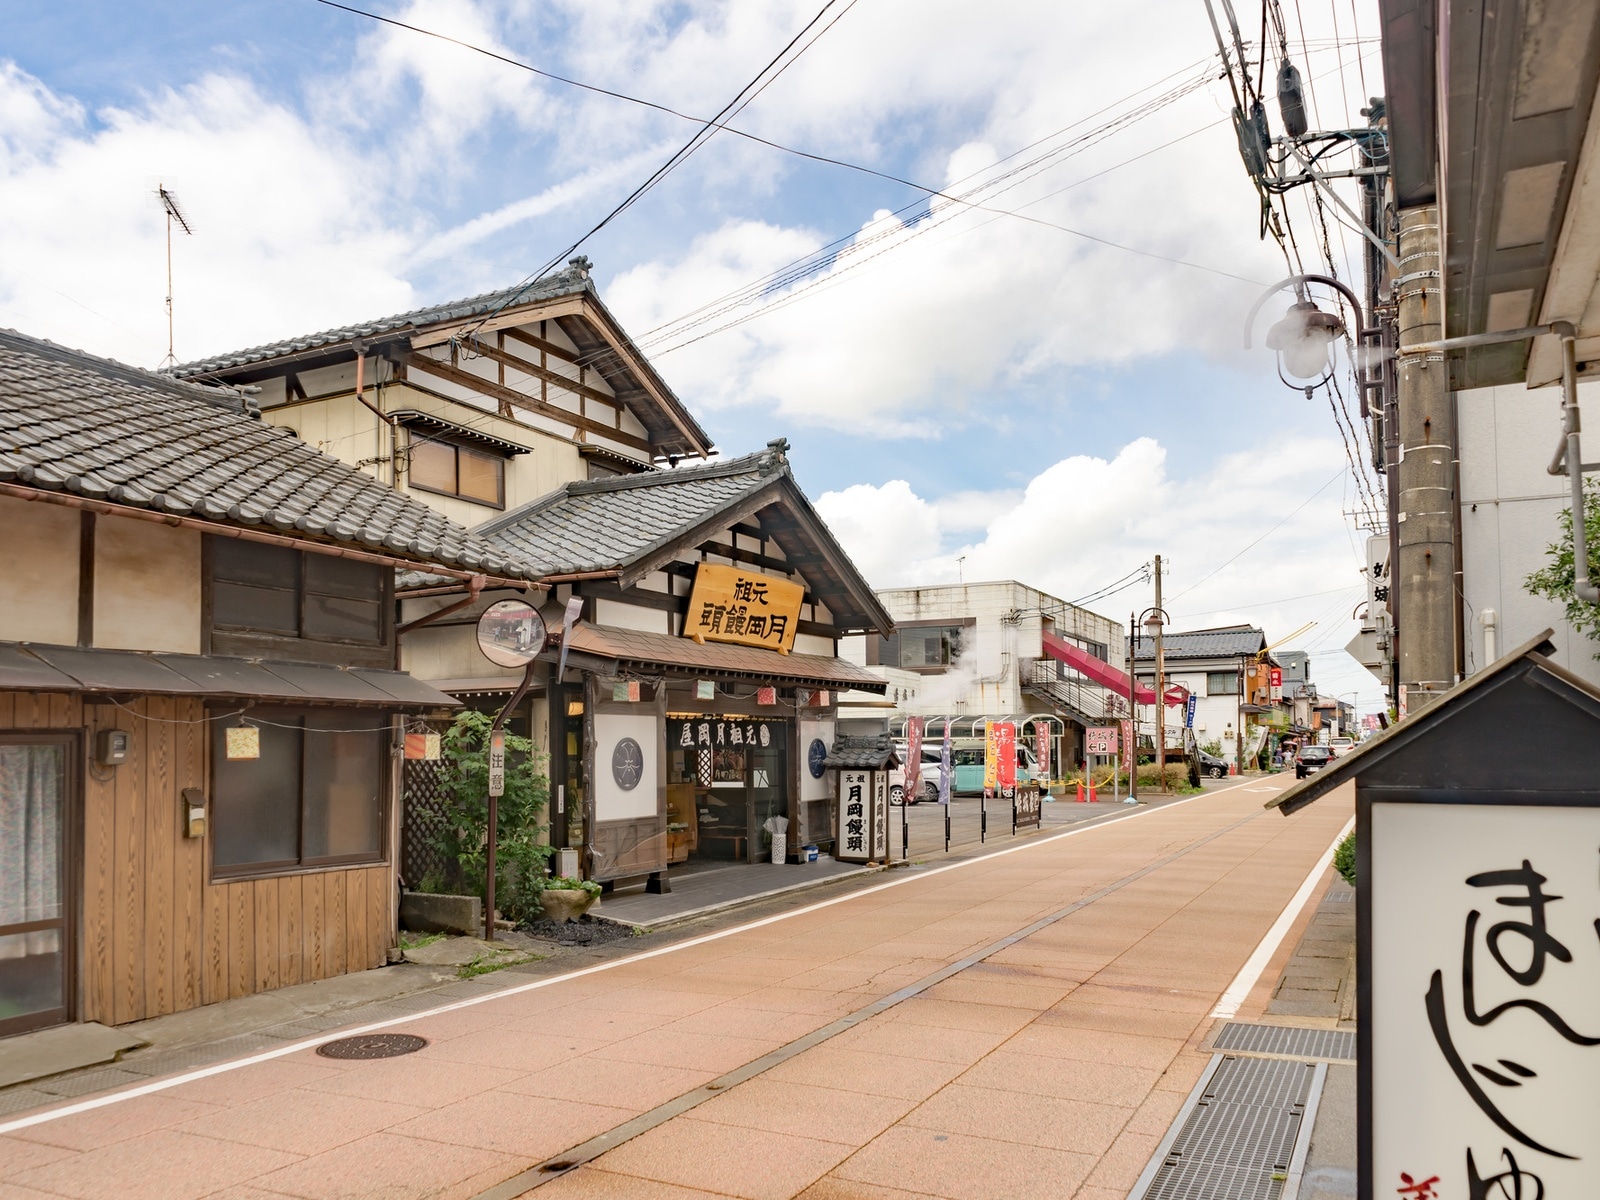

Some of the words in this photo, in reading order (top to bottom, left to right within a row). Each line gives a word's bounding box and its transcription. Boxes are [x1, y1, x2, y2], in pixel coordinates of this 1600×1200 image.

[733, 577, 769, 606] 元祖
[698, 601, 788, 644] 月岡饅頭
[491, 753, 503, 791] 注意
[846, 774, 866, 783] 元祖
[845, 784, 864, 852] 月岡饅頭
